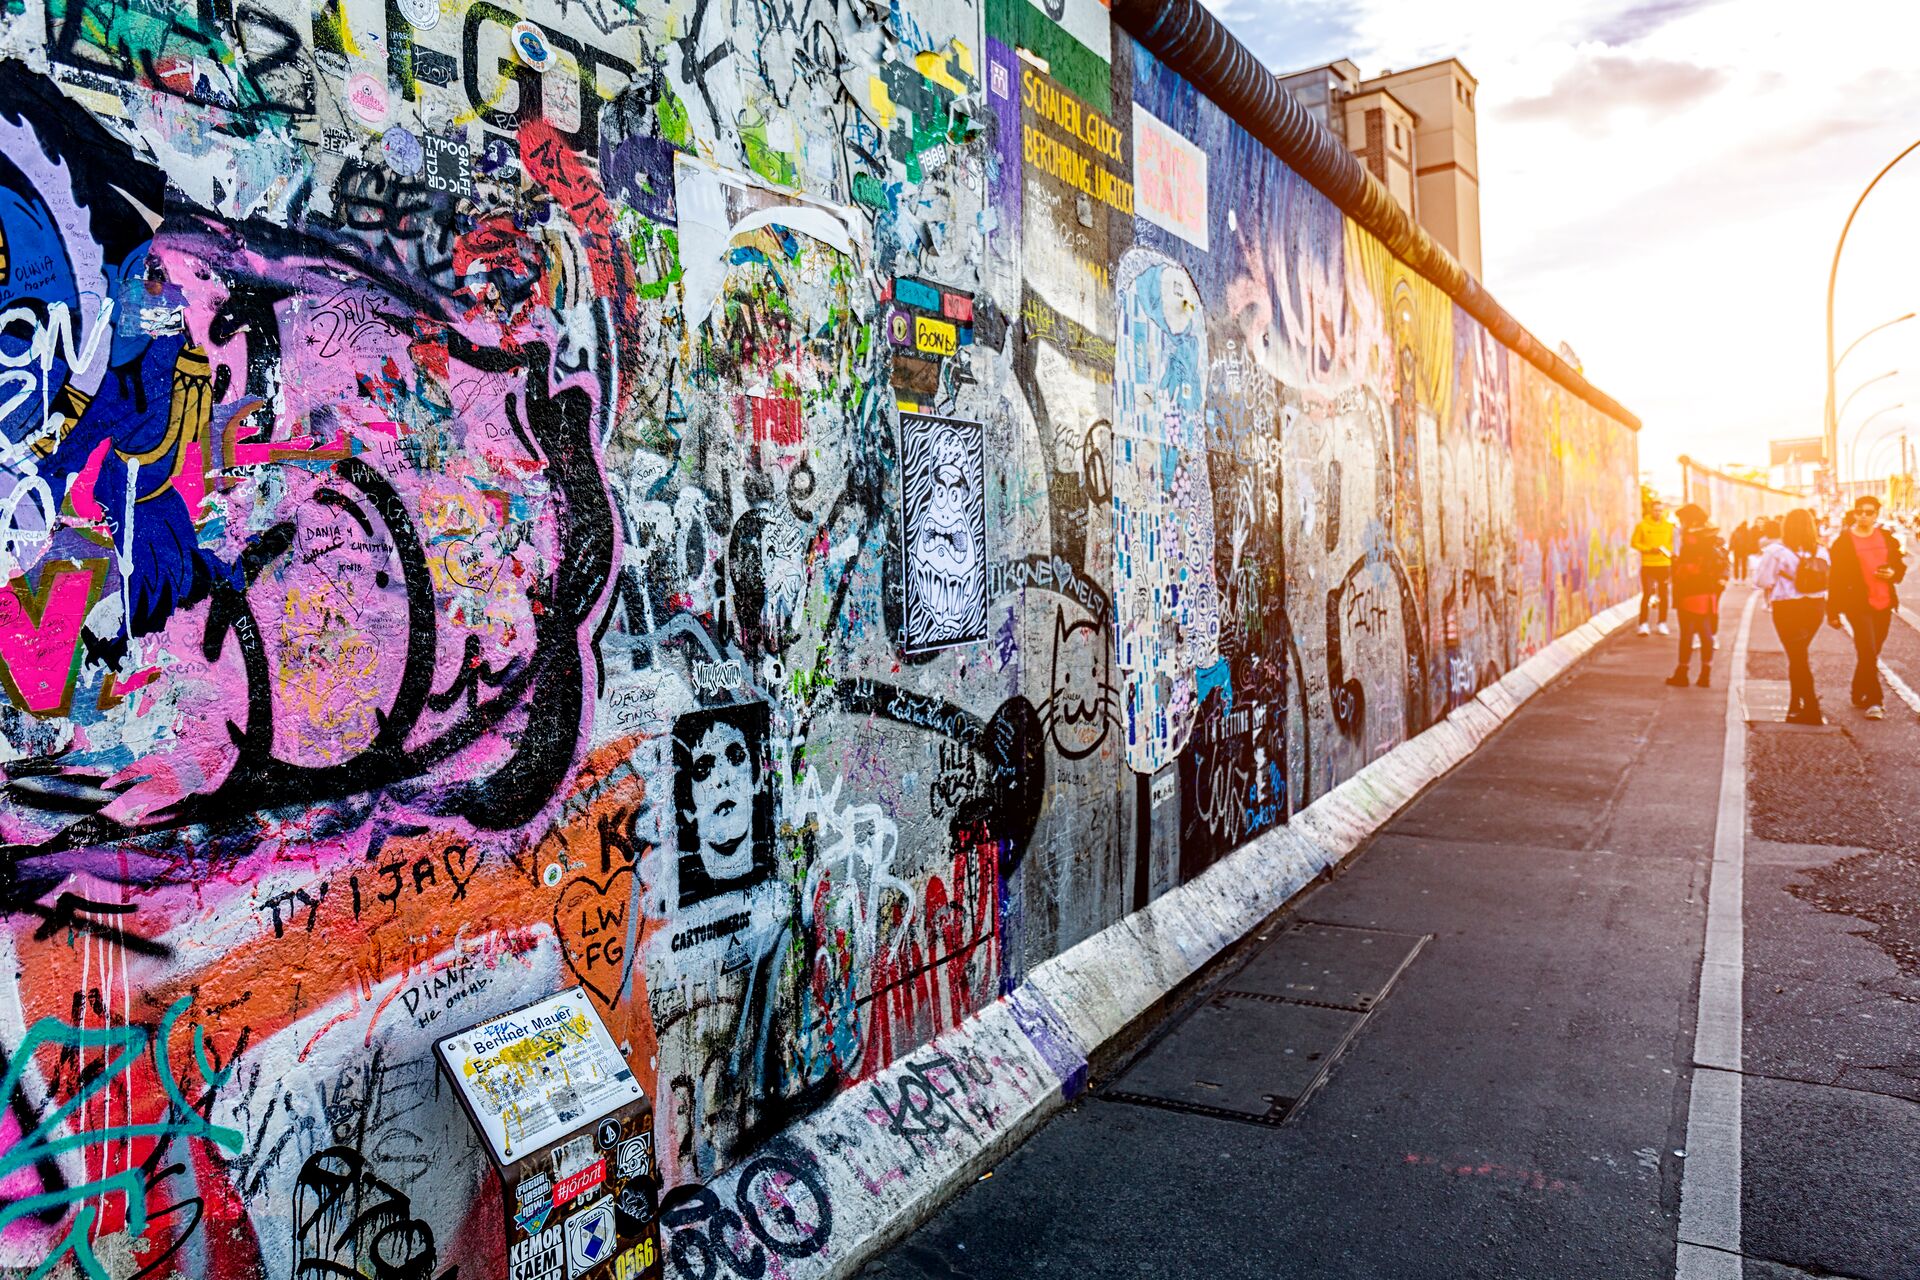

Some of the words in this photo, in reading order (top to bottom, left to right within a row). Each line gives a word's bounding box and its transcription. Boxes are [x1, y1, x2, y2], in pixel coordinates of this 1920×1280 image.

[582, 900, 626, 939] LW
[586, 936, 625, 971] FG
[473, 1025, 531, 1056] Berliner
[531, 1007, 573, 1033] Mauer
[510, 1223, 563, 1264] KEMOR
